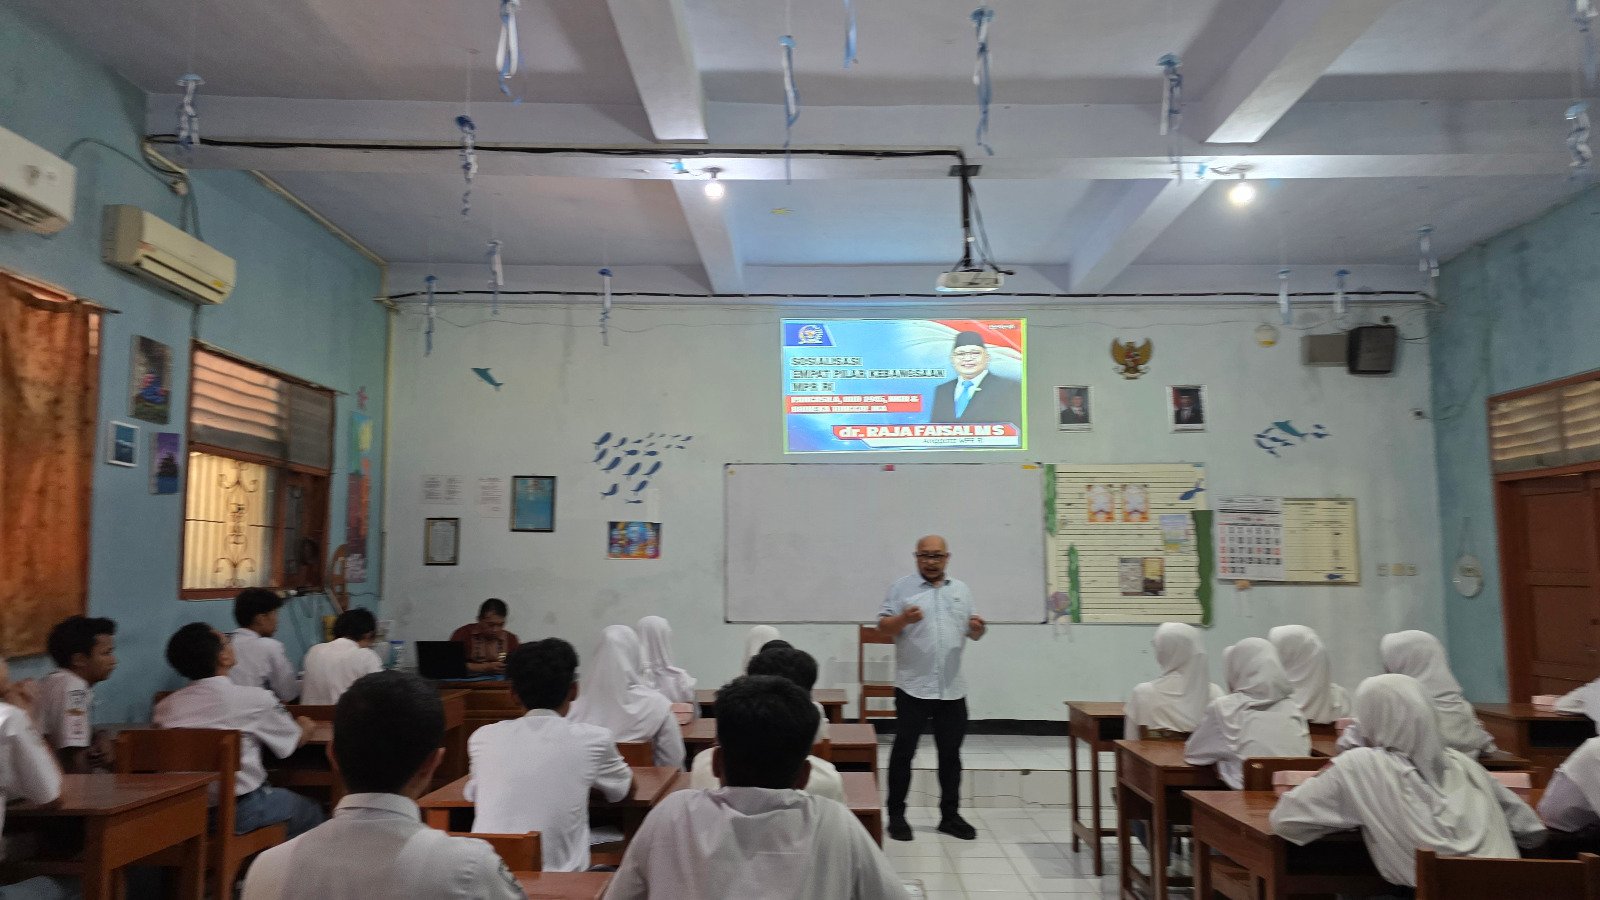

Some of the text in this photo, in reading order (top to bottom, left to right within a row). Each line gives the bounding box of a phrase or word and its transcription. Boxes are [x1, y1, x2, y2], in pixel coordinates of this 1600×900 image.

[791, 357, 862, 366] SOSIALISASI
[791, 369, 945, 379] EMPAT PILAR KEBANGSAAN
[791, 382, 835, 392] MPR RI
[838, 426, 865, 438] dr.
[866, 426, 914, 437] RAJA
[914, 425, 974, 437] FAISAL
